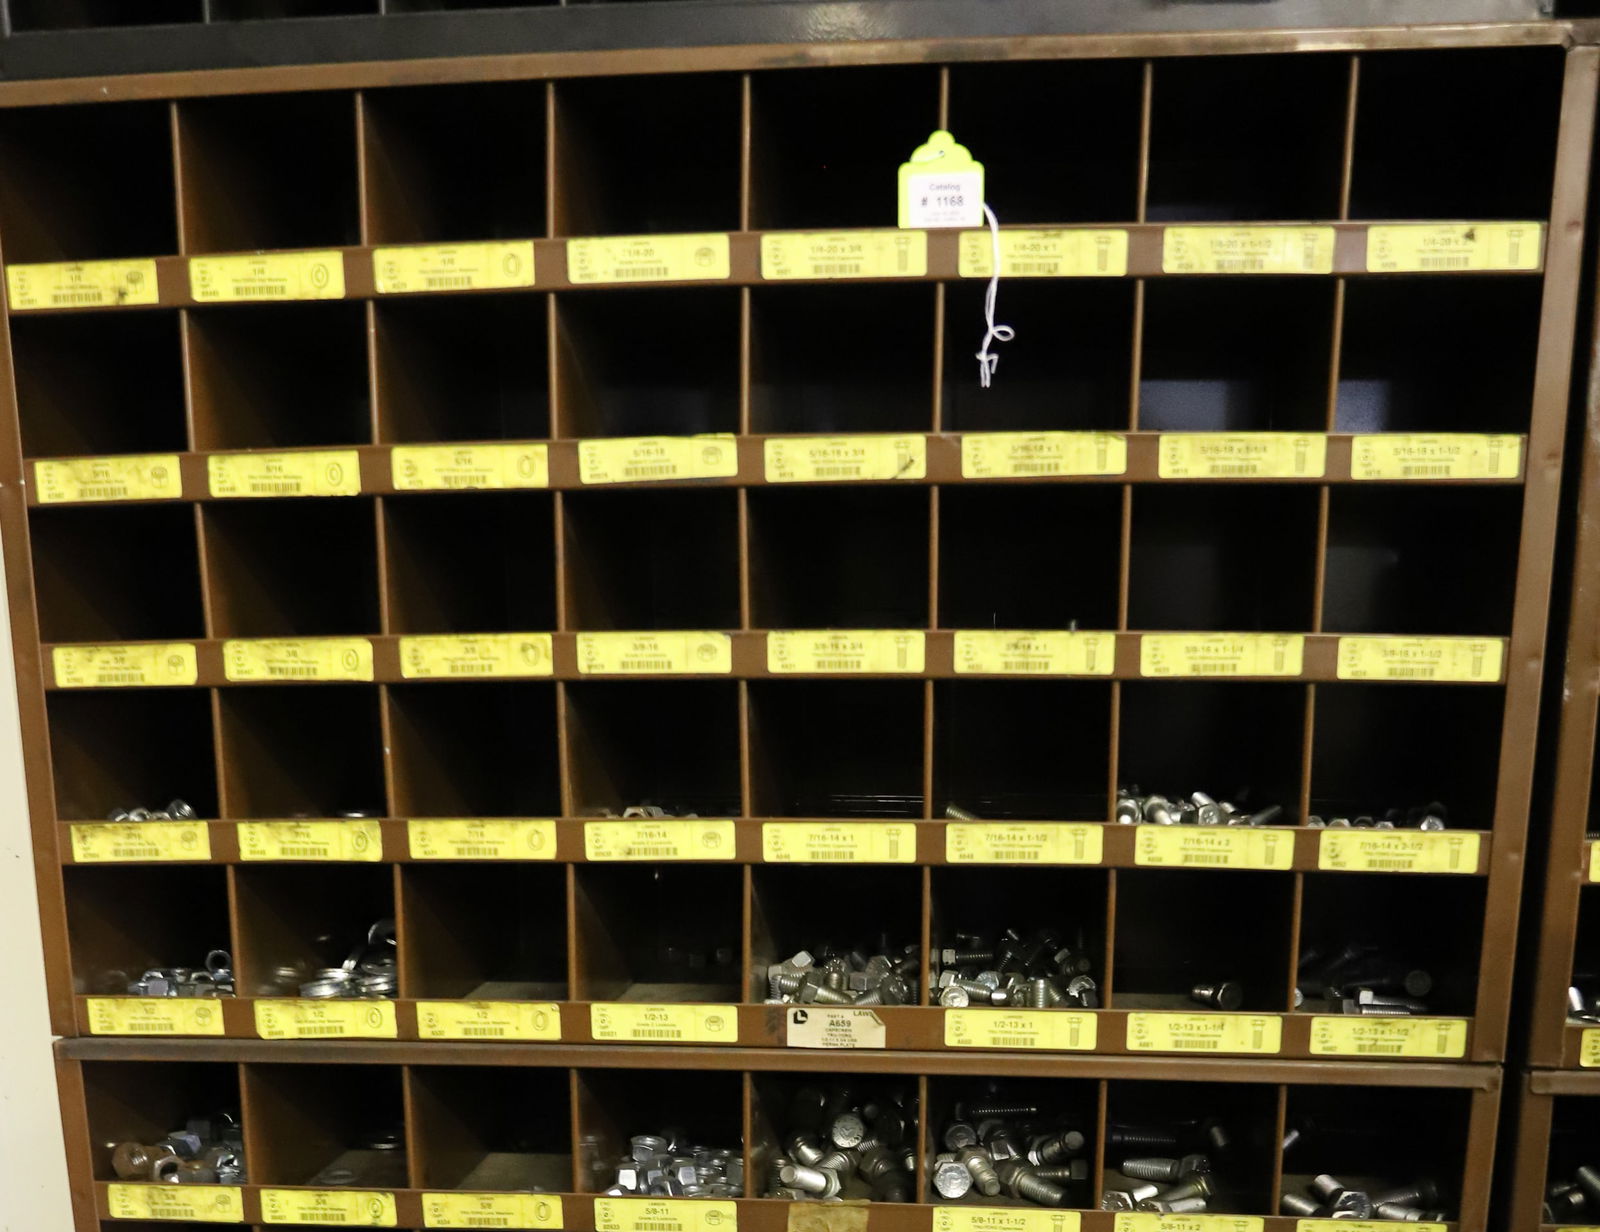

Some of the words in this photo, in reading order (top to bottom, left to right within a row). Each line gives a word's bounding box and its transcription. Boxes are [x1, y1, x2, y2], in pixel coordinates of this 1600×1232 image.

[929, 183, 961, 192] Catalog
[921, 195, 928, 206] #
[936, 195, 964, 207] 1168
[643, 1013, 670, 1022] 1/2-13
[993, 1020, 1020, 1030] 1/2-13
[1169, 1023, 1194, 1032] 1/2-13
[644, 1207, 670, 1216] 5/8-11
[970, 1216, 997, 1225] 5/8-11
[1006, 1217, 1027, 1226] 1-1/2
[1160, 1223, 1187, 1232] 5/8-11
